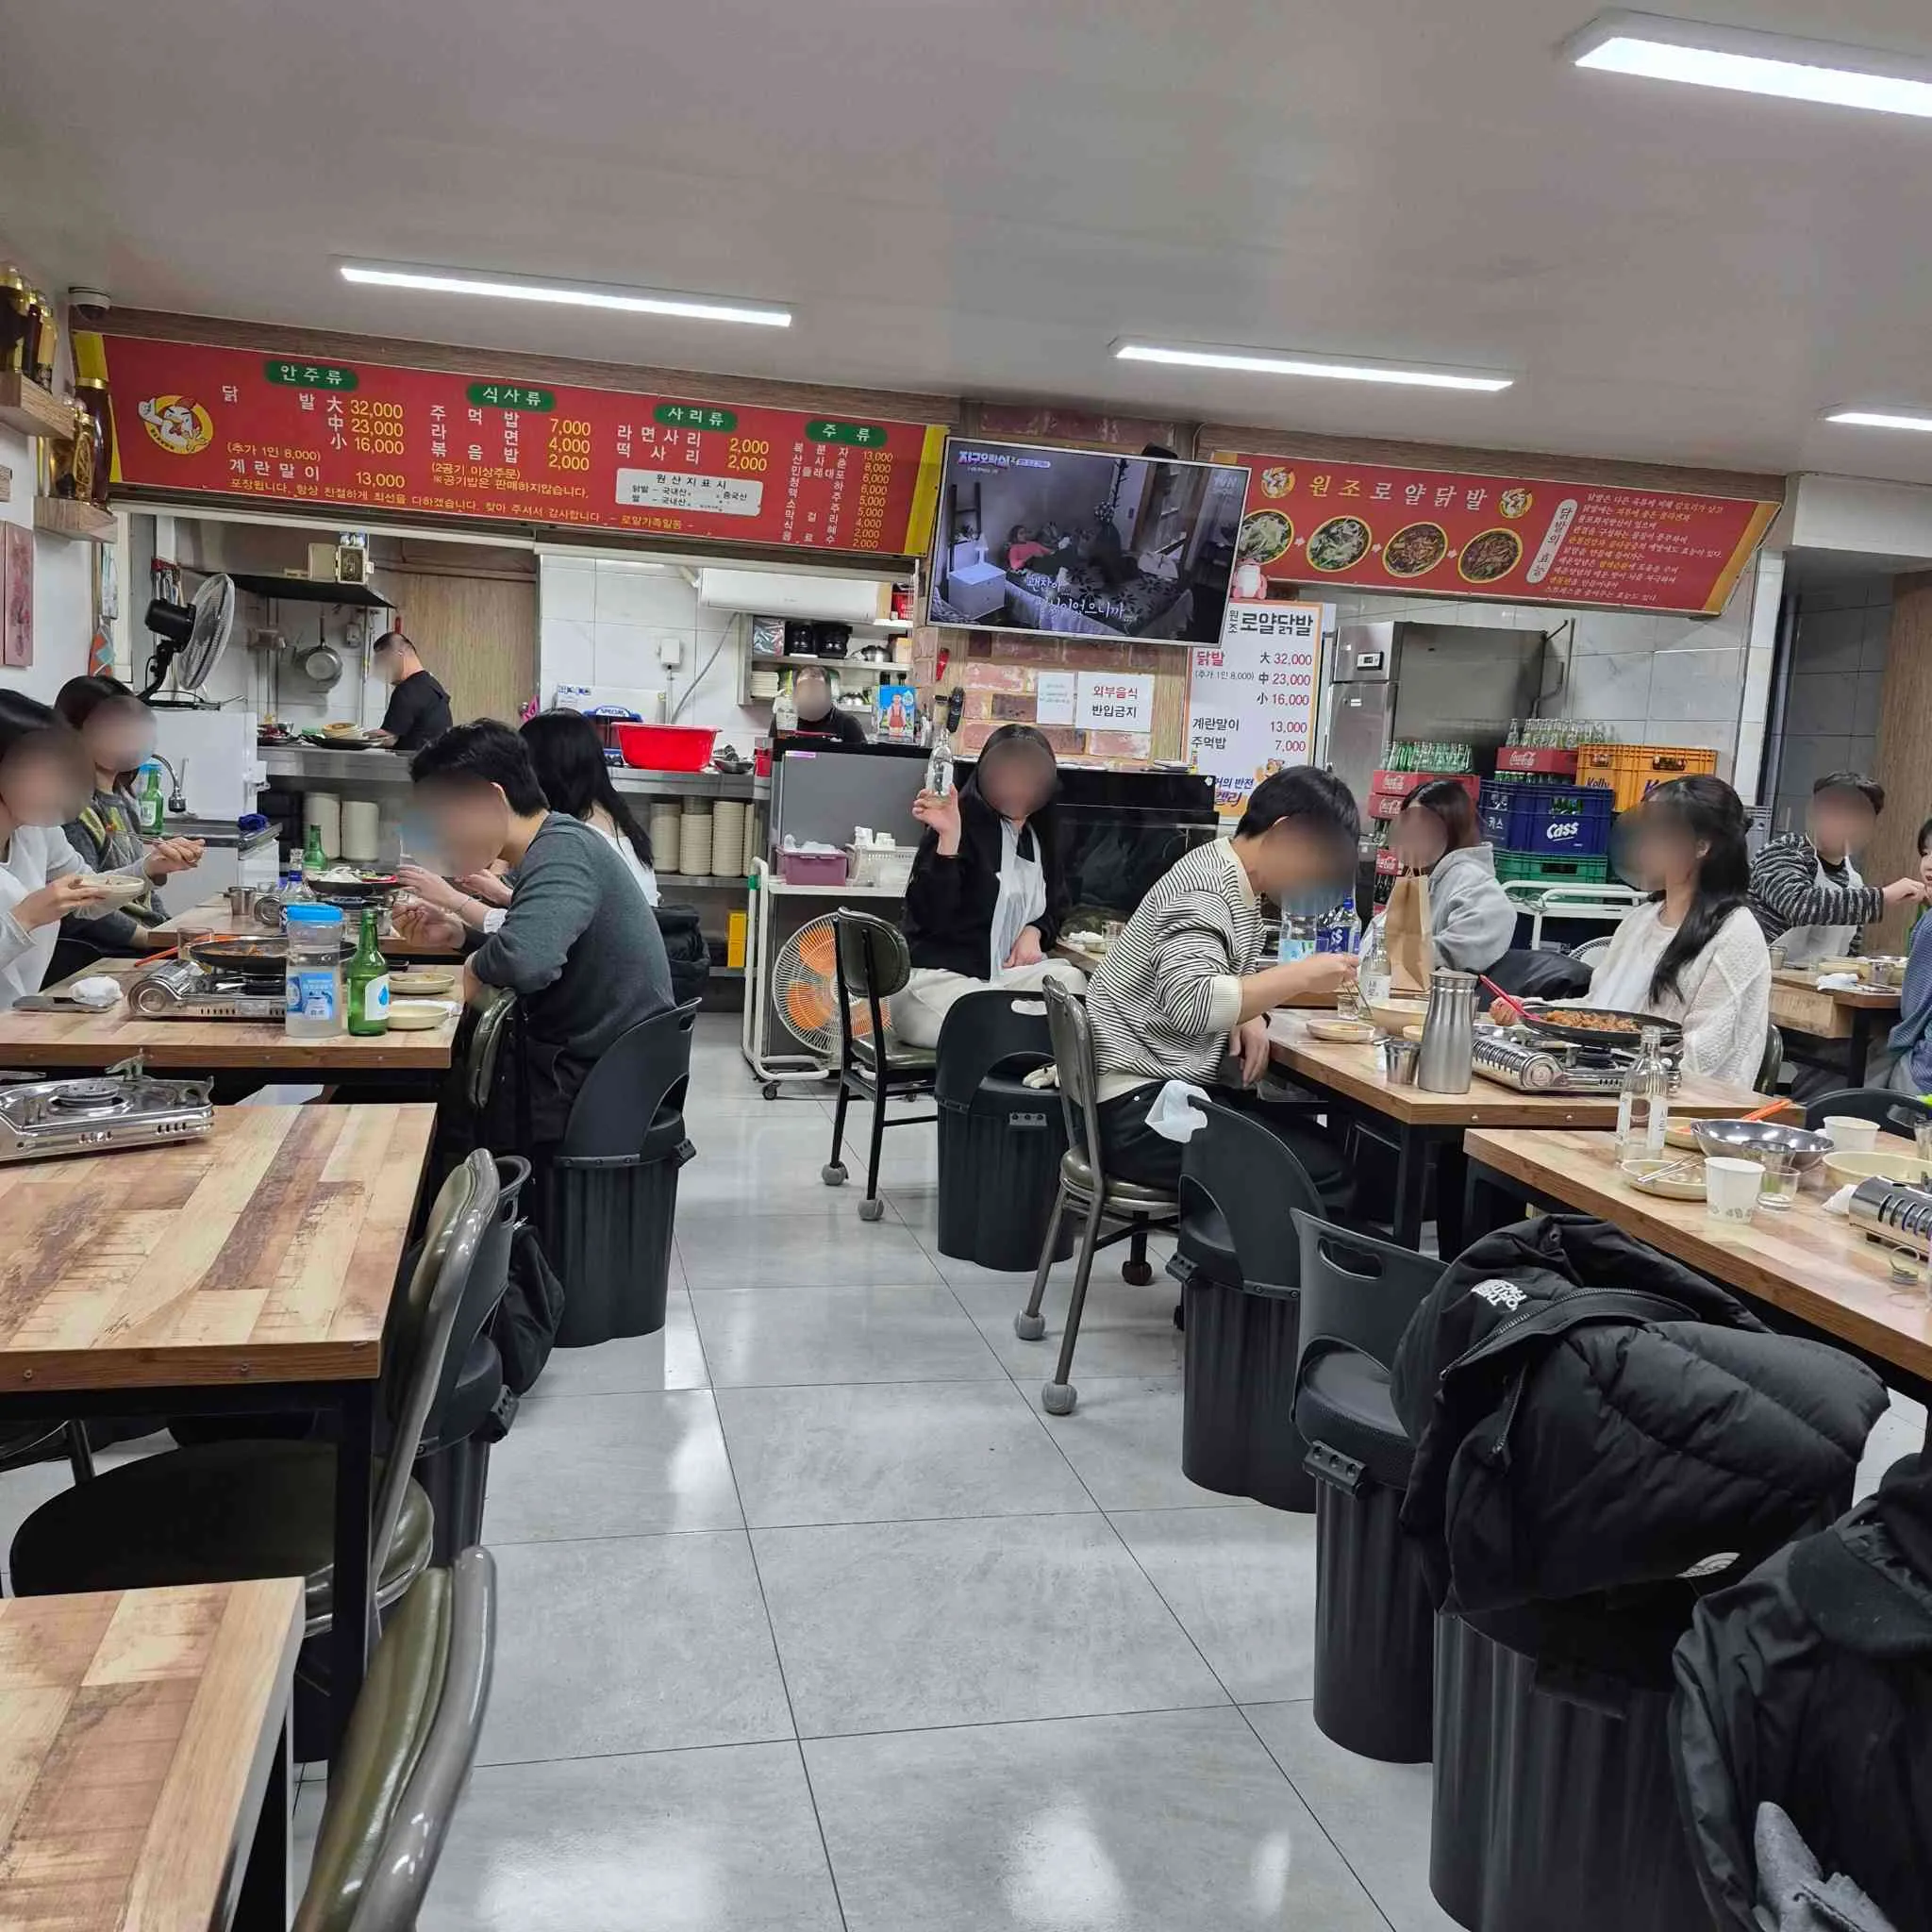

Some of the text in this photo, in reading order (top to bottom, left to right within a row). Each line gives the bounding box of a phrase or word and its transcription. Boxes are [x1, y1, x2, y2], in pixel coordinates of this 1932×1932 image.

[326, 395, 343, 413] 大
[350, 400, 404, 419] 32,000
[327, 414, 404, 437] 中 23,000
[550, 418, 591, 437] 7,000
[330, 433, 404, 455] 小 16,000
[549, 437, 591, 454] 4,000
[729, 438, 769, 455] 2,000
[549, 454, 590, 471] 2,000
[727, 455, 767, 472] 2,000
[862, 450, 893, 462] 13,000
[864, 463, 891, 474] 8,000
[356, 472, 405, 488] 13,000
[861, 474, 890, 484] 6,000
[296, 483, 318, 496] 항상
[855, 519, 882, 528] 4,000
[854, 528, 880, 540] 2,000
[853, 538, 878, 549] 2,000
[1240, 612, 1313, 637] 로얄닭발
[1196, 650, 1312, 667] 닭발 大 32,000
[1194, 670, 1214, 679] (추가
[1230, 672, 1255, 681] 8,000)
[1258, 672, 1269, 685] 中
[1272, 673, 1311, 686] 23,000
[1093, 686, 1139, 700] 외부음식
[1257, 691, 1309, 707] 小 16,000
[1091, 705, 1137, 718] 반입금지
[1192, 717, 1307, 733] 계란말이 13,000
[1191, 736, 1306, 752] 주먹밥 7,000
[1235, 777, 1255, 790] 반전
[1488, 817, 1504, 831] 카스
[1546, 821, 1579, 840] Cass
